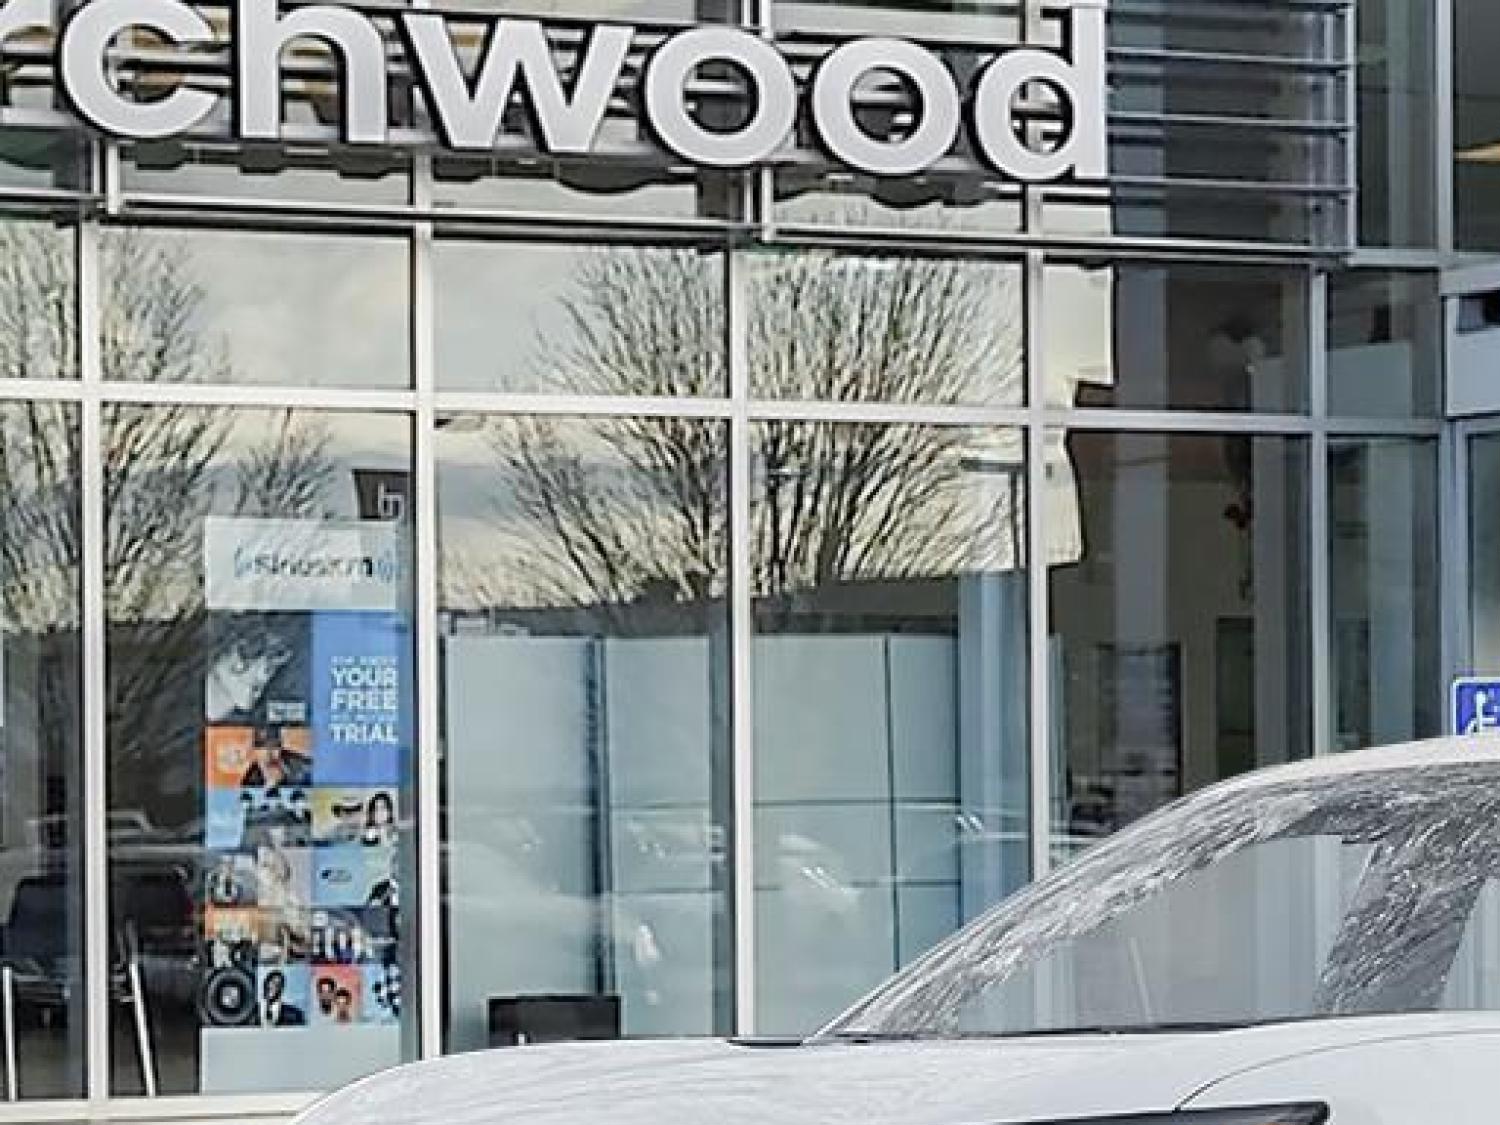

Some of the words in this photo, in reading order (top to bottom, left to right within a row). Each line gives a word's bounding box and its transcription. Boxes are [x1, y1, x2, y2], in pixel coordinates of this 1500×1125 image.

[331, 665, 399, 687] YOUR
[331, 688, 398, 710] FREE
[328, 722, 399, 744] TRIAL
